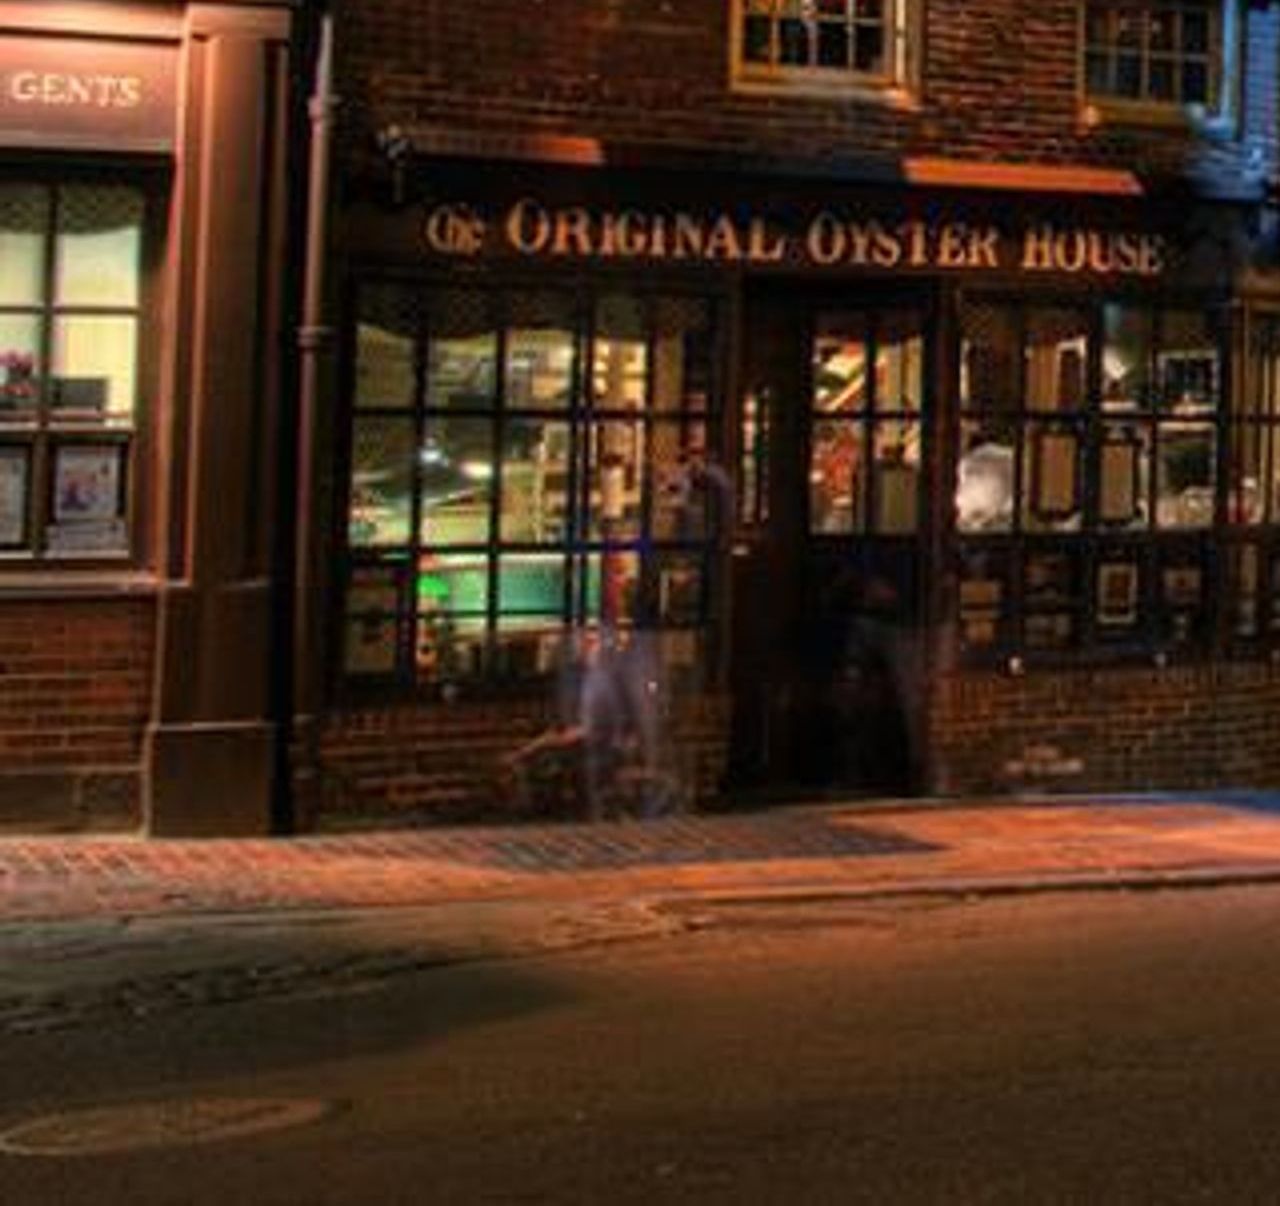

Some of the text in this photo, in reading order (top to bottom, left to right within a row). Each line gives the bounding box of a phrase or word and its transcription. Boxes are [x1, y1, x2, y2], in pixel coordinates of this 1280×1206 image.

[10, 71, 142, 108] GENTS
[506, 196, 787, 261] ORIGINAL
[806, 209, 999, 269] OYSTER
[1021, 222, 1165, 274] HOUSE
